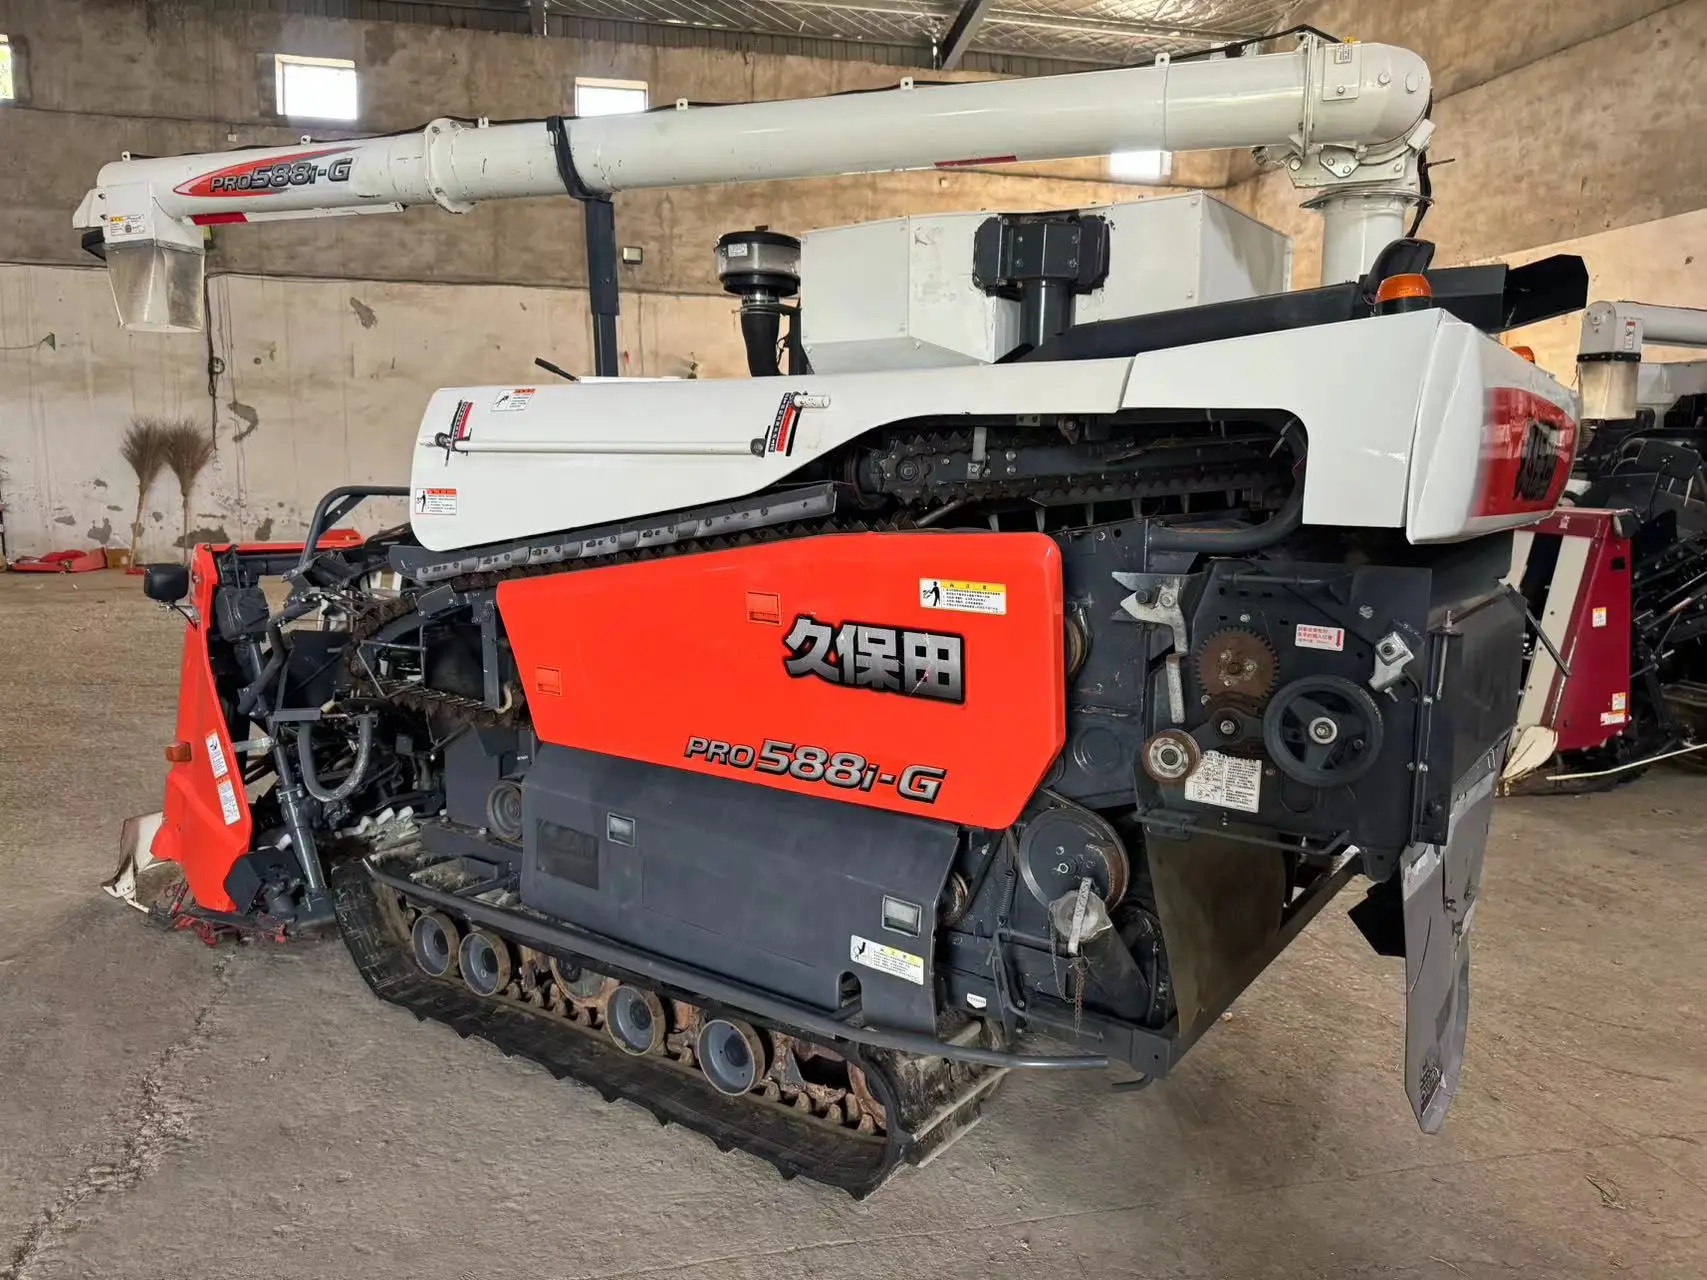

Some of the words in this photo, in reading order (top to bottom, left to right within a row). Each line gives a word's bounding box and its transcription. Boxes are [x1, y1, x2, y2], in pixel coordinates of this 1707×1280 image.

[210, 157, 353, 192] PRO588i-G
[784, 616, 964, 703] 久保田
[684, 736, 947, 804] PRO588i-G
